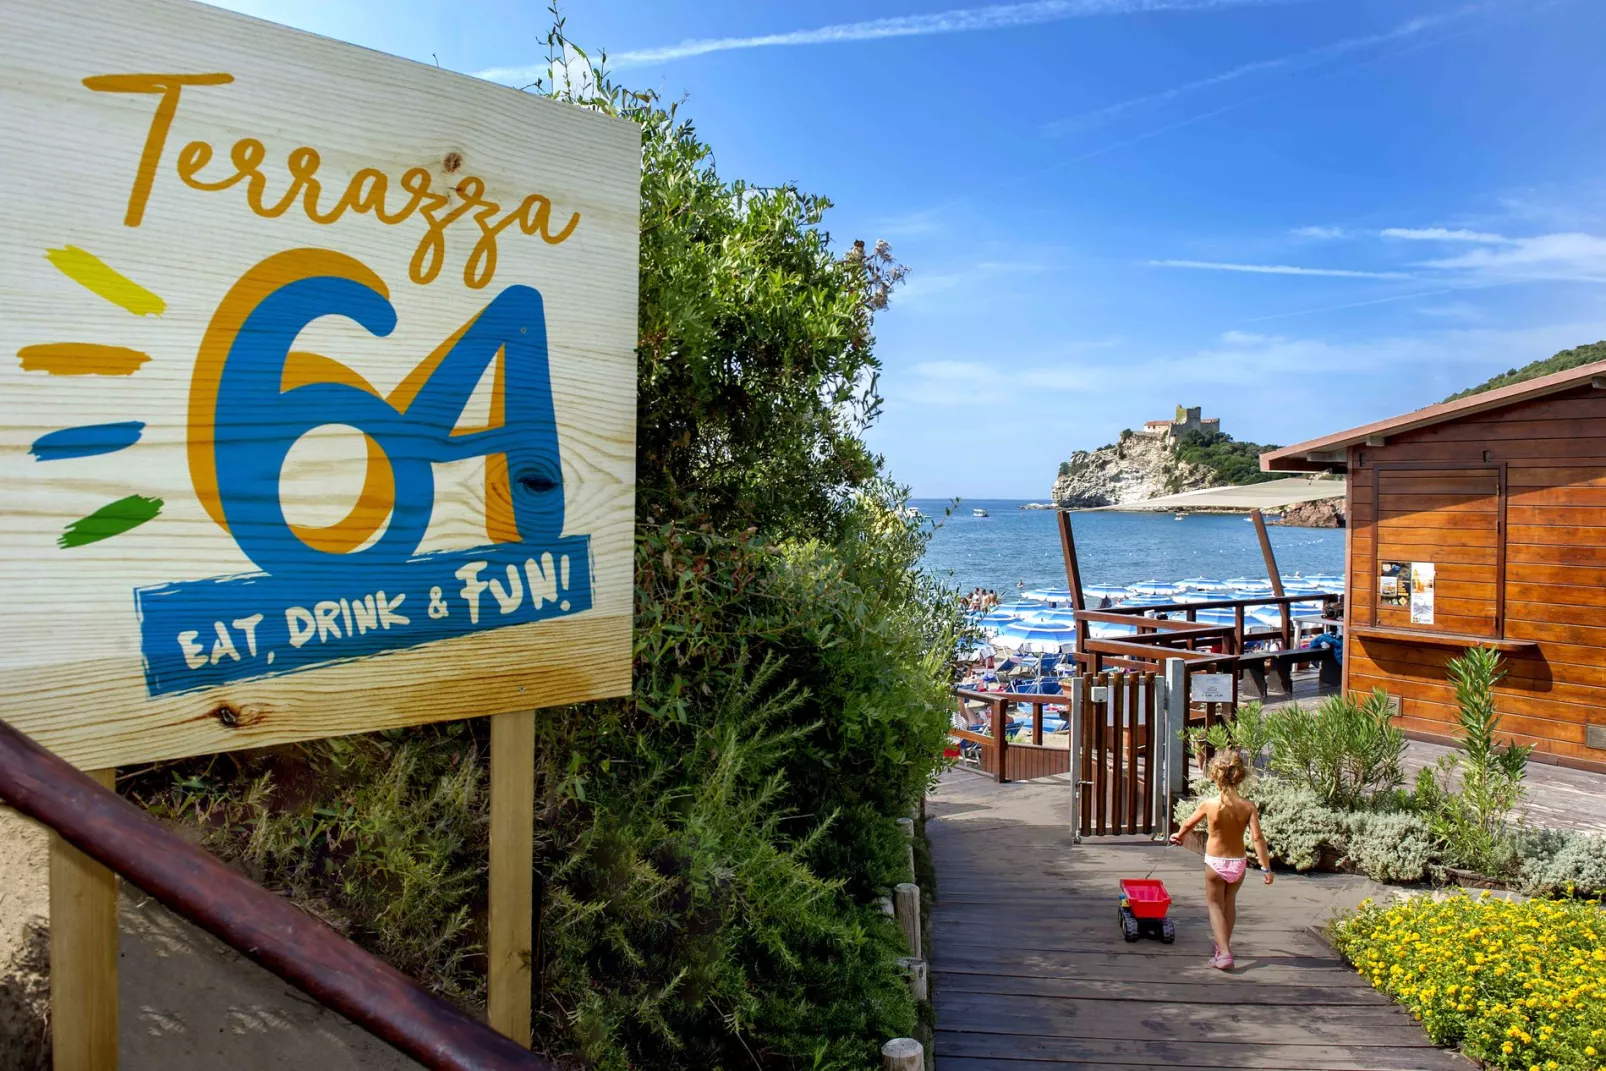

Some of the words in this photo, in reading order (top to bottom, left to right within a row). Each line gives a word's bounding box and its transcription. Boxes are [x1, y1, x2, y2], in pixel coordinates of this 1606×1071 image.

[82, 72, 581, 290] Terrazza
[177, 613, 275, 670] EAT,
[285, 590, 411, 648] DRINK
[427, 586, 449, 619] &
[454, 551, 571, 624] FUN!
